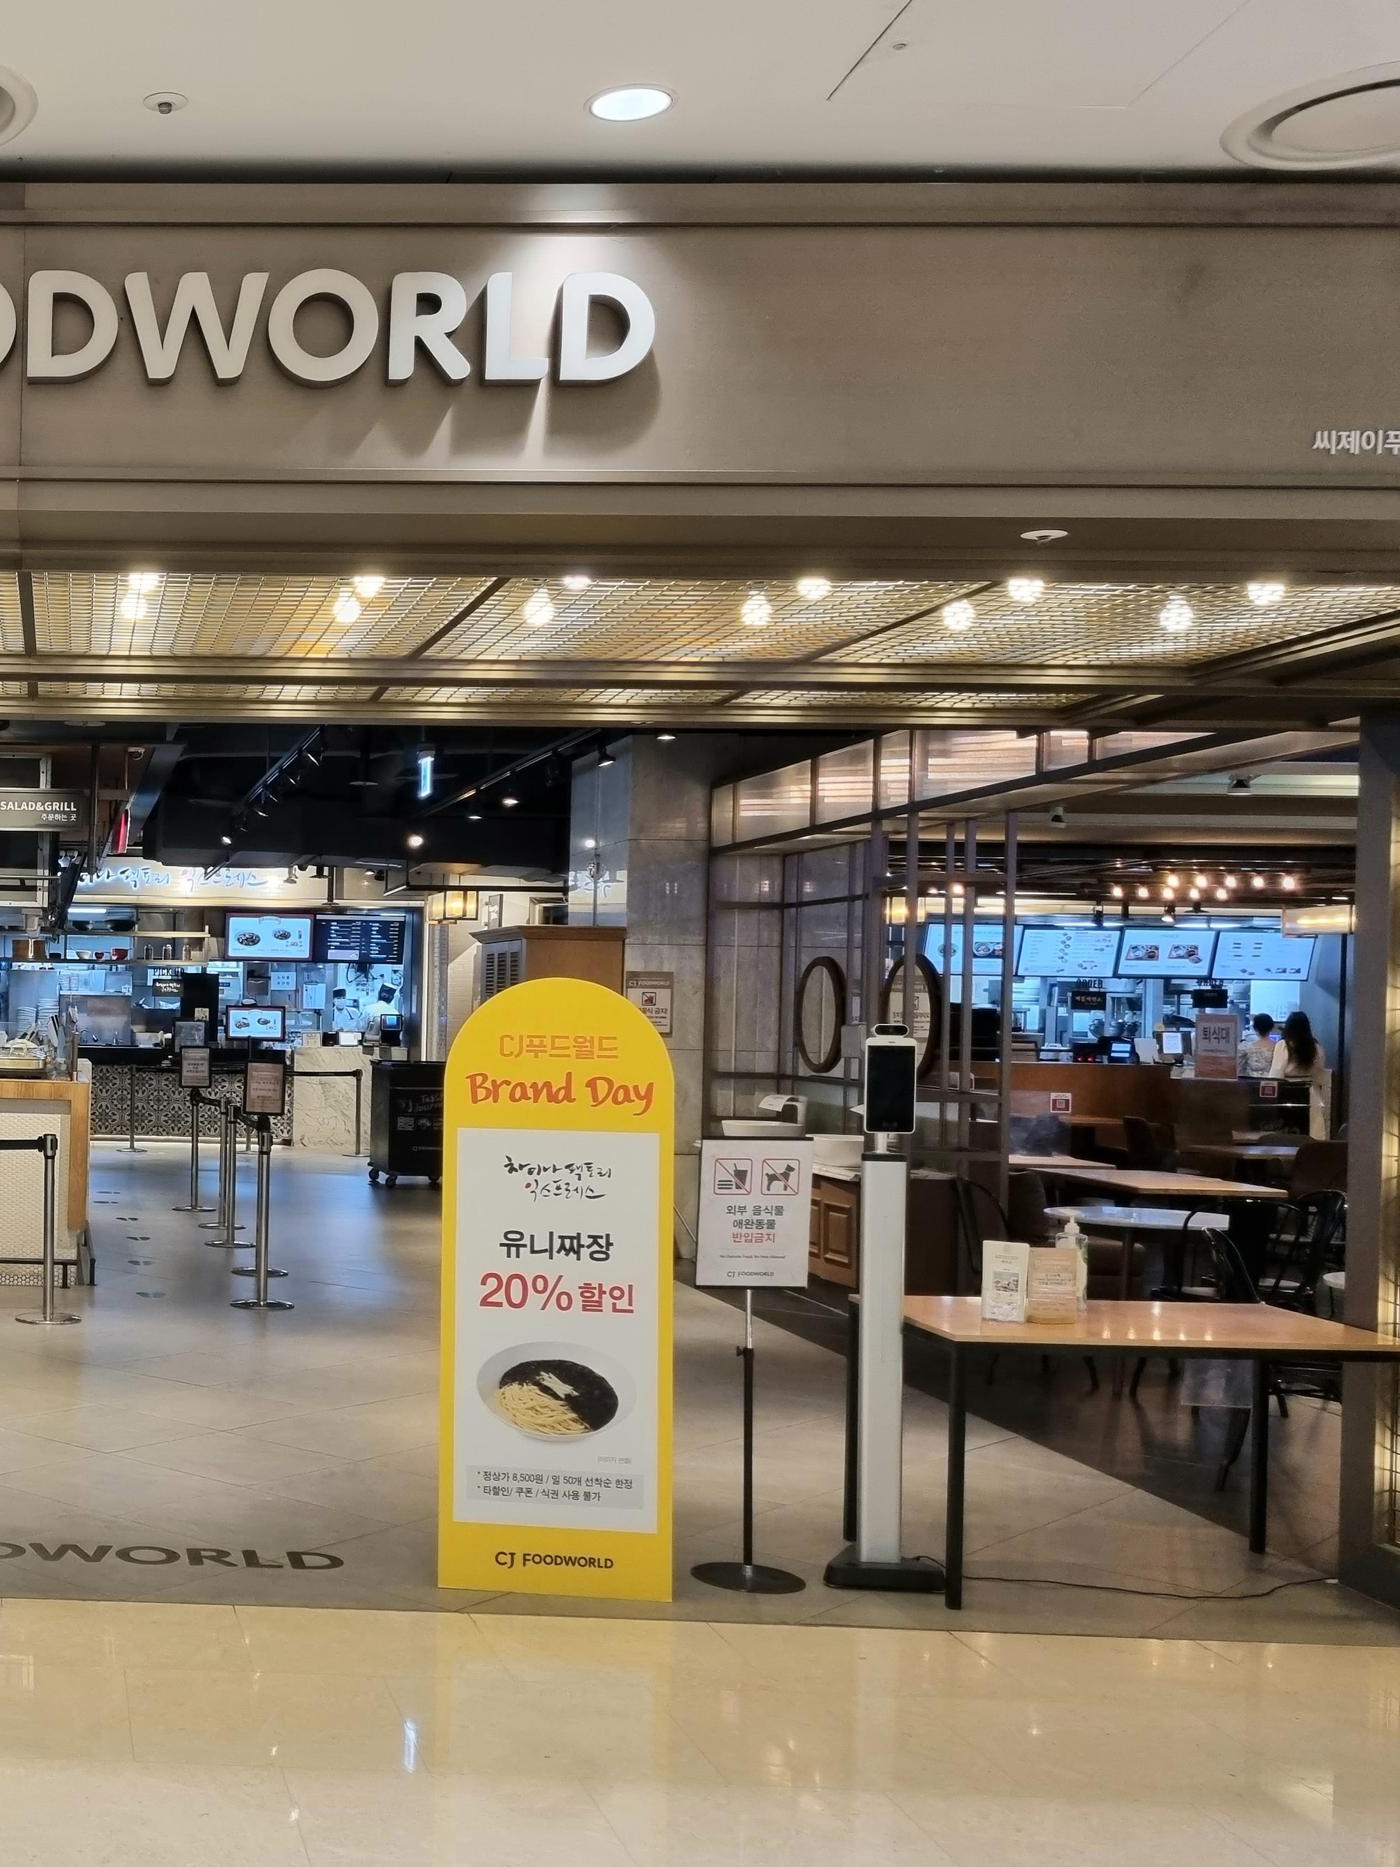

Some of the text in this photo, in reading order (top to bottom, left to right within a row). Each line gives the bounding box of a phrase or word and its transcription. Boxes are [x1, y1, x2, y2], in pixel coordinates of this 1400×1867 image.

[0, 801, 77, 811] SALAD&GRILL
[70, 813, 77, 821] 곳
[499, 1034, 620, 1060] CJ푸드월드
[465, 1071, 576, 1105] Brand
[585, 1076, 655, 1116] Day
[503, 1155, 612, 1181] 차이나 팩토리
[524, 1178, 607, 1202] 익스프레스
[726, 1205, 785, 1217] 외부 음식물
[732, 1218, 777, 1230] 애완동물
[499, 1229, 614, 1262] 유니짜장
[732, 1232, 776, 1244] 반입금지
[479, 1271, 635, 1315] 20% 할인
[482, 1471, 633, 1490] 정상가 8,500원 일 50개 선착순 한정
[515, 1487, 533, 1499] 쿠폰
[541, 1488, 560, 1500] 식권
[561, 1489, 581, 1501] 사용
[582, 1490, 602, 1502] 불가
[495, 1551, 614, 1569] CJ FOODWORLD
